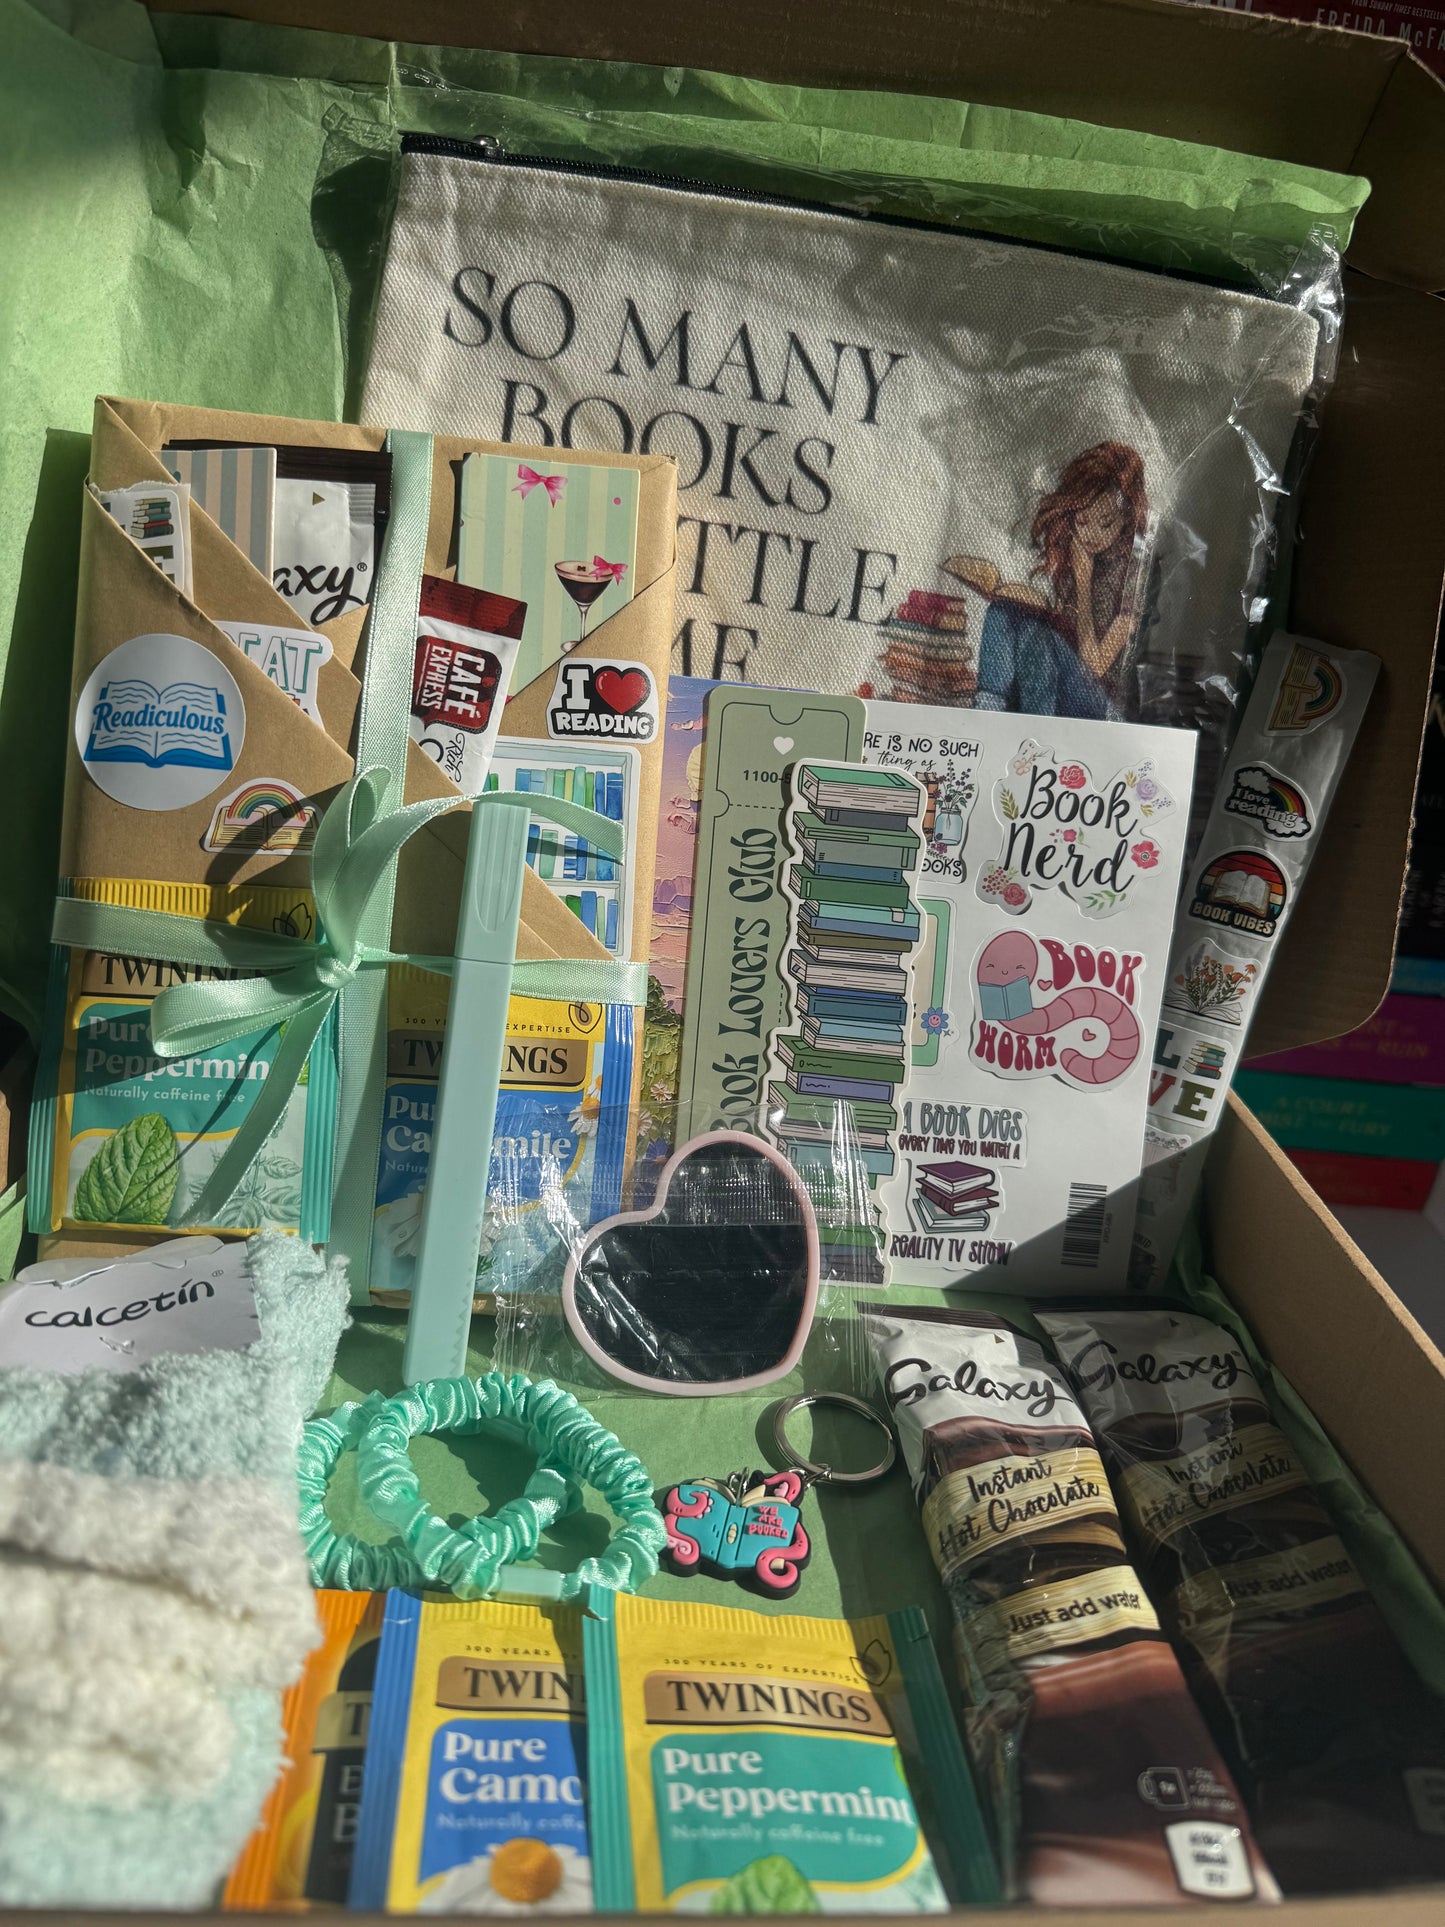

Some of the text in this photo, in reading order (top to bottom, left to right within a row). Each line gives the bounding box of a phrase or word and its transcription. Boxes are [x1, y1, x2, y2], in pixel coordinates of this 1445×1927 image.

[1315, 8, 1386, 37] FREIDA
[1393, 3, 1412, 15] TIMES
[444, 266, 908, 426] SO MANY
[501, 379, 836, 515] BOOKS
[676, 515, 899, 626] TTLE
[421, 645, 453, 711] EXPRESS
[443, 651, 486, 719] CAFÉ
[566, 668, 591, 710] I
[93, 702, 225, 736] Readiculous
[555, 711, 653, 736] READING
[877, 750, 937, 772] thing as
[908, 738, 933, 753] NO
[939, 739, 979, 757] SUCH
[1019, 765, 1138, 838] Book
[1235, 788, 1271, 805] I love
[1228, 799, 1298, 829] reading
[727, 828, 778, 903] Club
[921, 859, 962, 877] OOKS
[1192, 902, 1275, 936] BOOK VIBES
[718, 917, 770, 1039] Lovers
[1039, 939, 1143, 1006] BOOK
[88, 1015, 152, 1043] Pur
[974, 1020, 1057, 1071] WORM
[84, 1048, 271, 1082] Peppermin
[84, 1083, 149, 1101] Naturally
[153, 1087, 211, 1102] caffeine
[902, 1101, 913, 1134] A
[920, 1102, 972, 1139] BOOK
[958, 1138, 977, 1157] YOU
[979, 1140, 1012, 1160] WATCH
[1013, 1143, 1021, 1161] A
[889, 1234, 1013, 1266] REALITY TV SHOW
[1070, 1340, 1254, 1392] Galaxy
[884, 1357, 1074, 1418] Galaxy
[966, 1457, 1053, 1504] Instant
[757, 1505, 779, 1516] WE
[757, 1515, 784, 1527] ARE
[937, 1475, 1101, 1566] Hot Chocolate
[747, 1524, 789, 1540] BOOKED
[1268, 1571, 1306, 1591] add
[1308, 1557, 1353, 1582] water
[1008, 1589, 1141, 1633] Just add water
[501, 1648, 552, 1657] YEARS
[700, 1659, 747, 1669] YEARS
[666, 1680, 872, 1724] TWININGS
[442, 1730, 548, 1764] Pure
[661, 1747, 764, 1775] Pure
[439, 1766, 585, 1807] Camo
